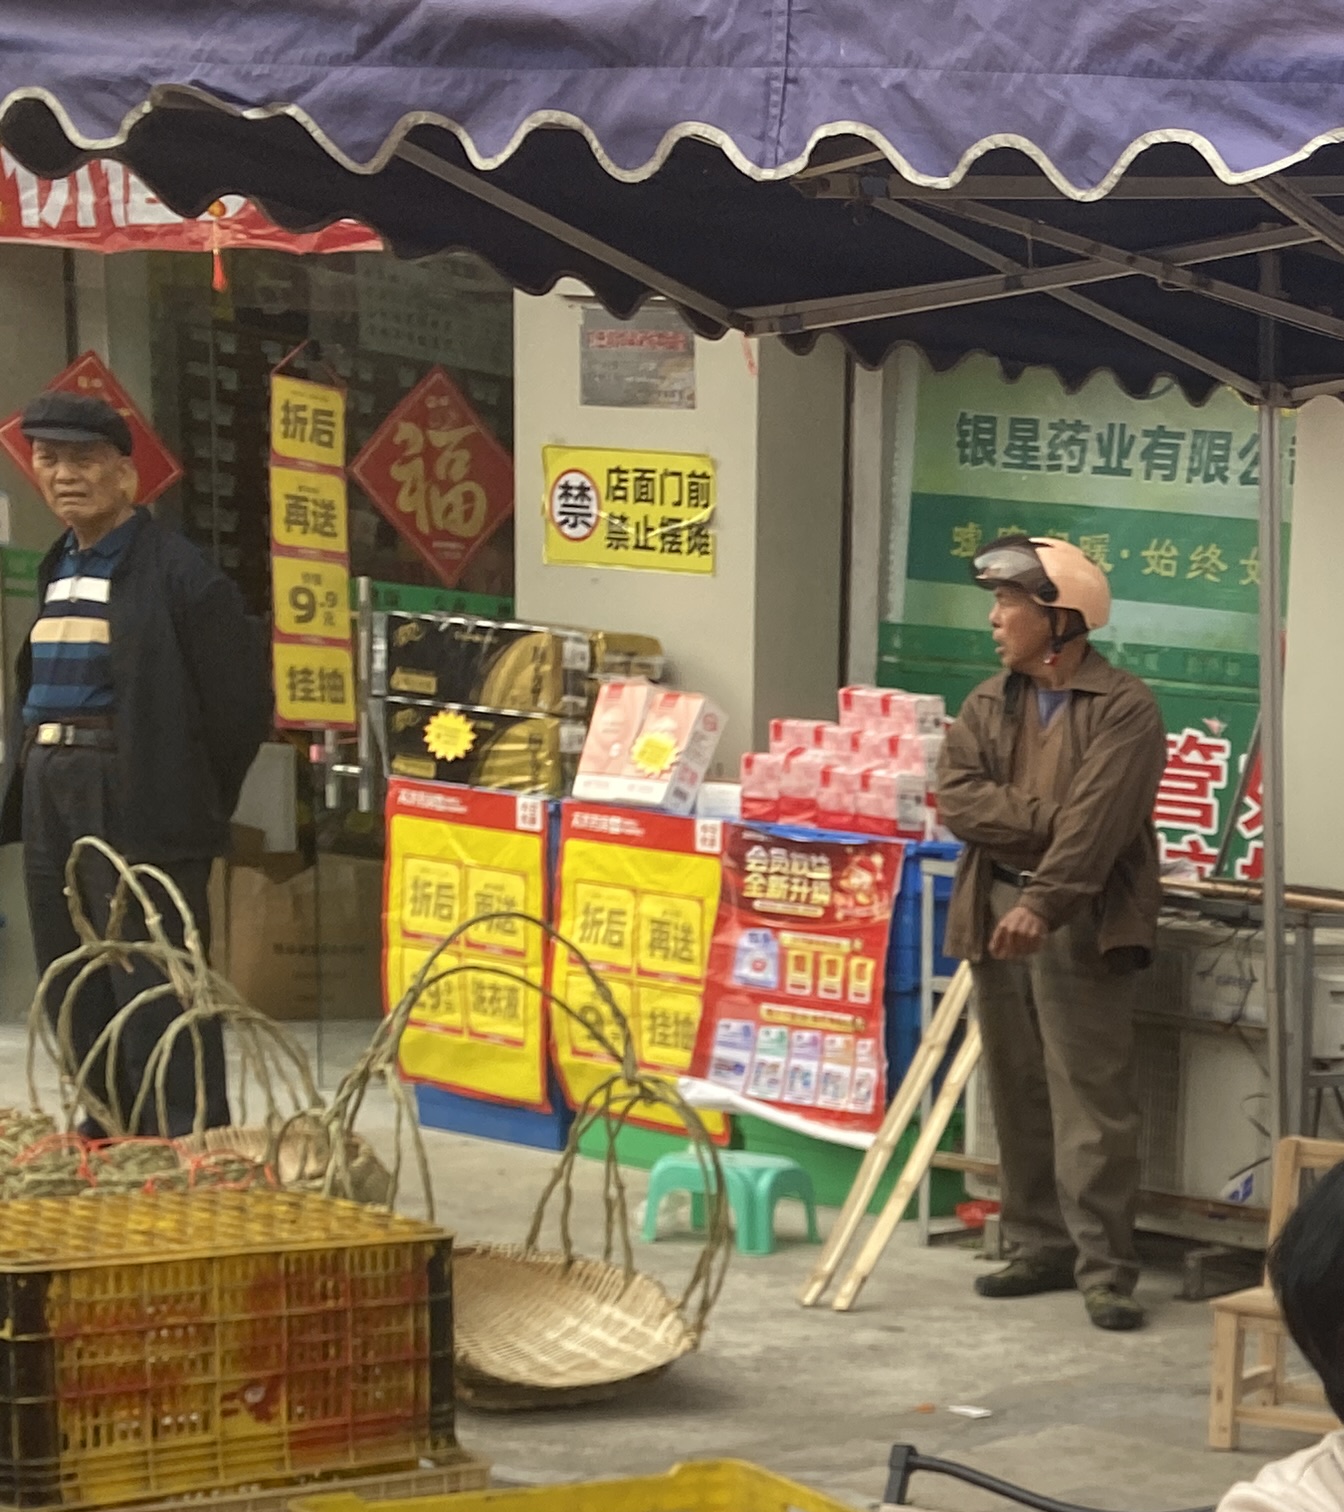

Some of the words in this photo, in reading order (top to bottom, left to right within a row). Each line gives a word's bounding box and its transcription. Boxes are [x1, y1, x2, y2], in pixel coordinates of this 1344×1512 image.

[281, 399, 336, 449] 折后
[955, 410, 1297, 488] 银星药业有限公
[390, 419, 488, 539] 福
[605, 465, 711, 509] 店面门前
[283, 493, 338, 538] 再送
[558, 480, 592, 529] 禁
[604, 512, 712, 557] 禁止摆摊
[411, 874, 456, 923] 折后
[579, 902, 627, 949] 折后
[649, 917, 694, 963] 再送
